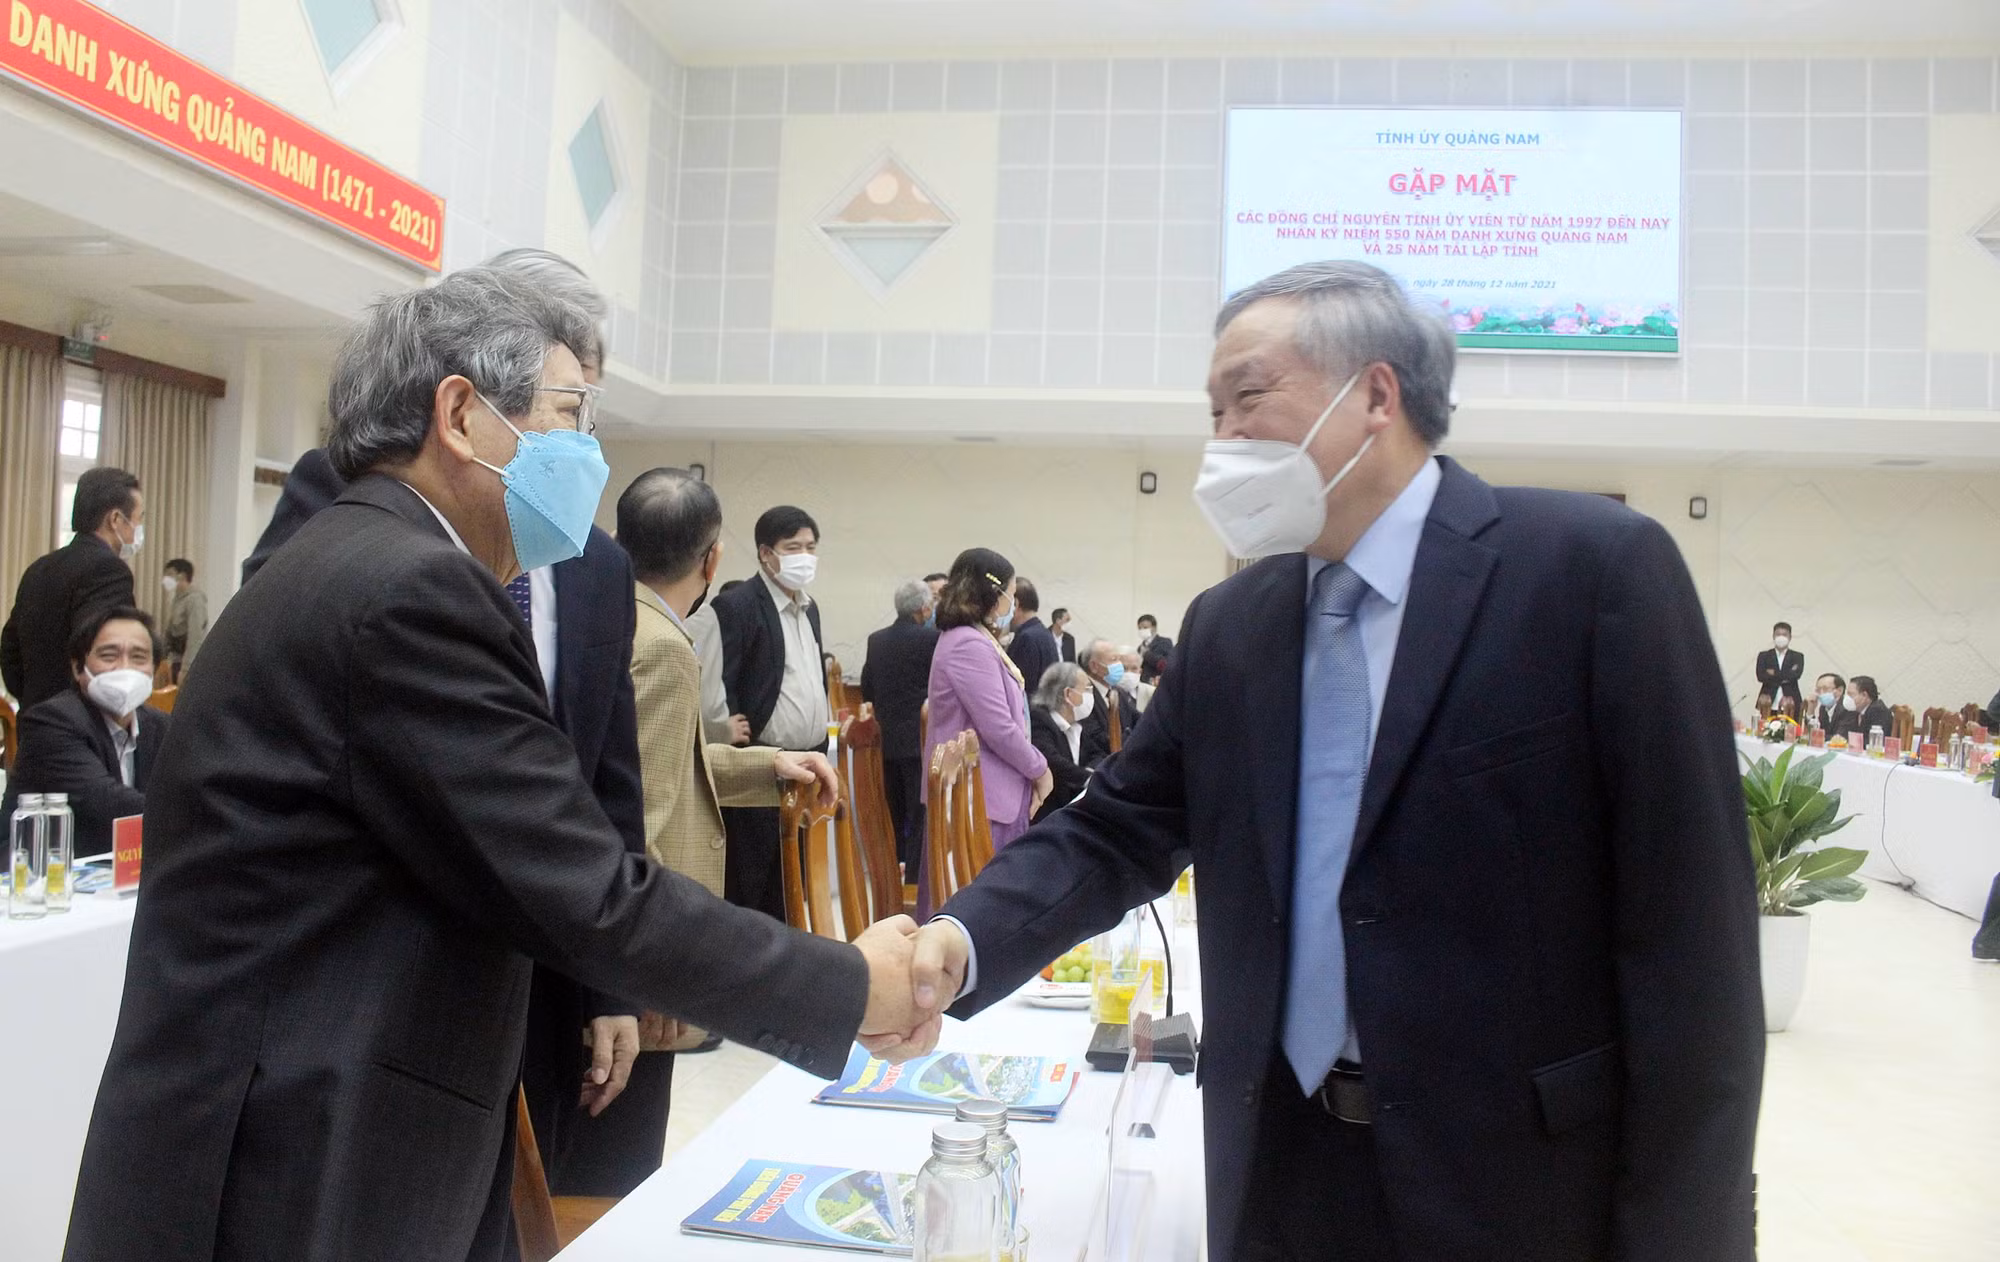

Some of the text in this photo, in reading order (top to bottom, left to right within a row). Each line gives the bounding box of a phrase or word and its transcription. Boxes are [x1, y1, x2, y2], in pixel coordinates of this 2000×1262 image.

[10, 0, 436, 252] DANH XƯNG QUẢNG NAM (1471 - 2021)
[1445, 130, 1500, 147] QUẢNG
[1505, 133, 1540, 145] NAM
[1389, 167, 1517, 201] GẶP MẶT
[1569, 216, 1602, 228] 1997
[1641, 217, 1670, 230] NAY
[1386, 228, 1411, 241] 550
[1451, 229, 1492, 242] DANH
[1596, 231, 1629, 244] NAM
[1386, 243, 1403, 256] 25
[1413, 279, 1438, 289] ngày
[1441, 279, 1453, 288] 28
[1456, 279, 1487, 290] tháng
[1489, 280, 1503, 288] 12
[1531, 280, 1557, 289] 2021
